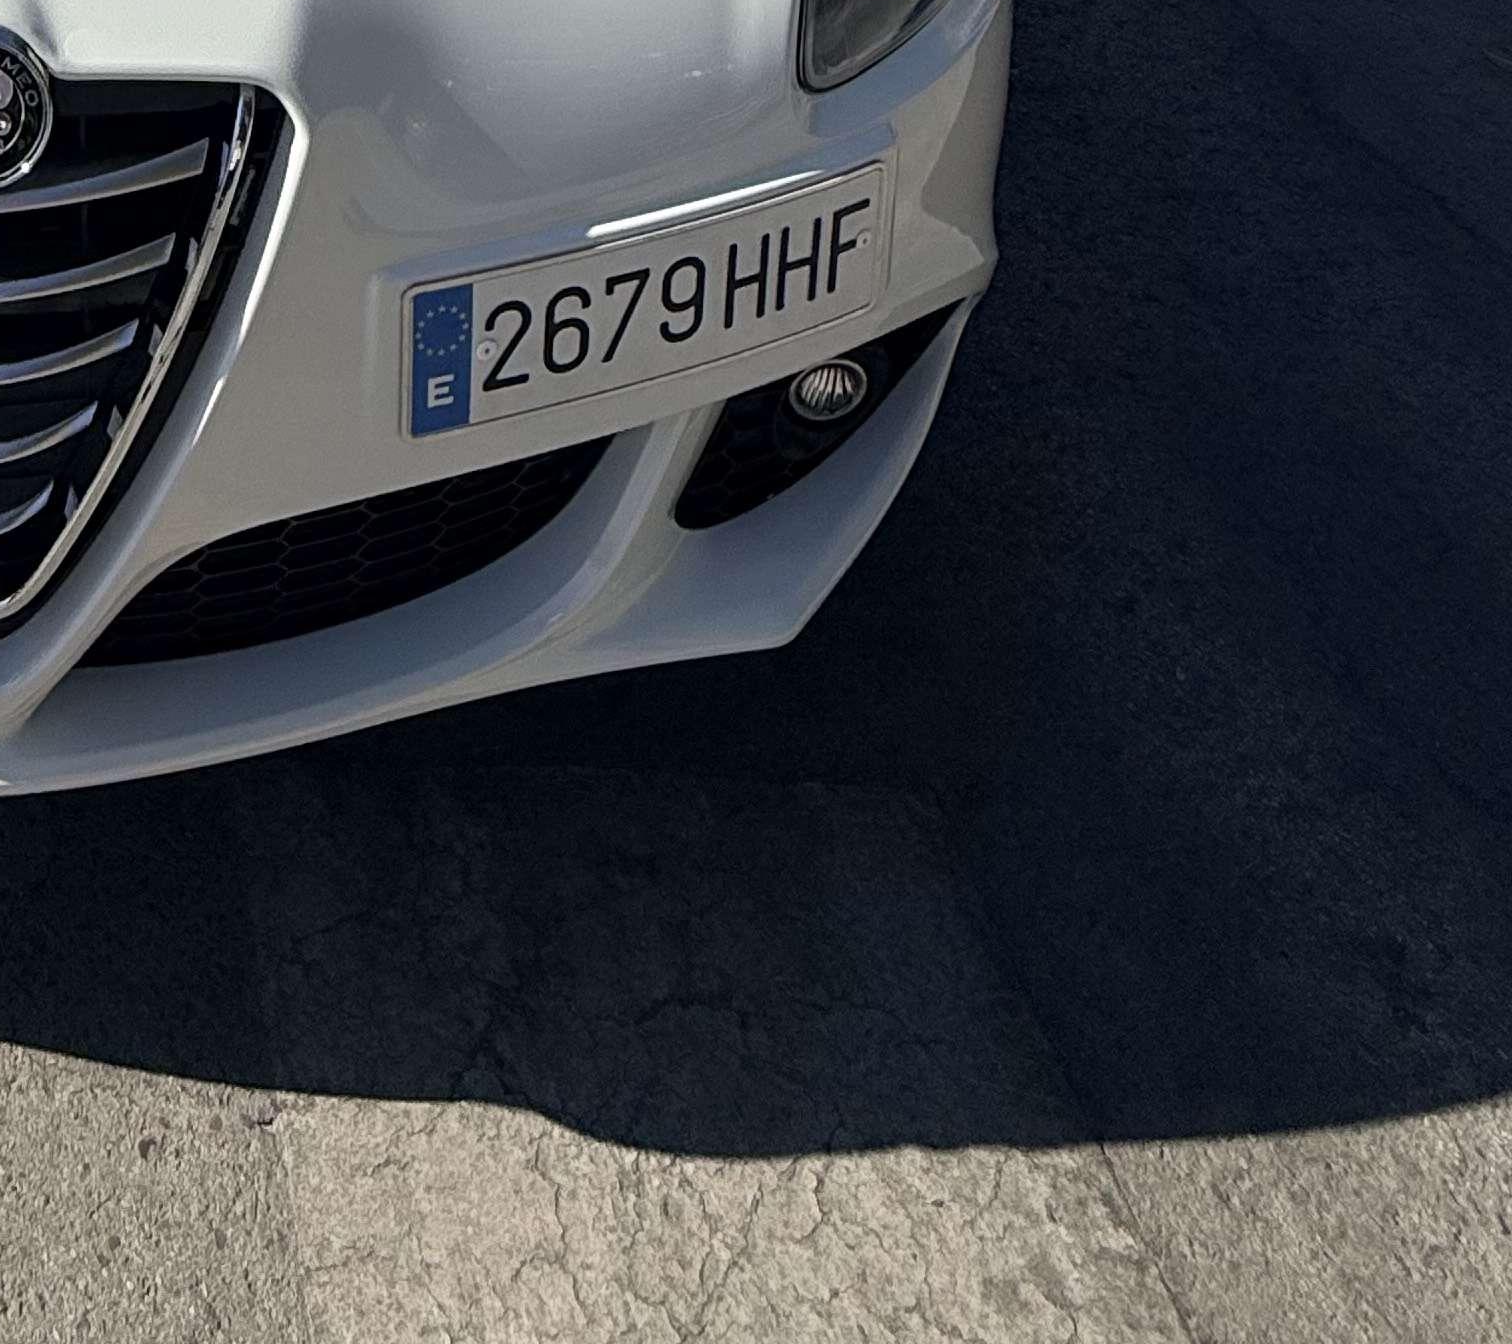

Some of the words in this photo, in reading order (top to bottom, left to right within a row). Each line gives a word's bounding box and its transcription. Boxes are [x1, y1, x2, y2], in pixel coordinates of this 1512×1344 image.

[482, 255, 706, 392] 2679
[724, 198, 870, 329] HHF
[427, 374, 455, 409] E
